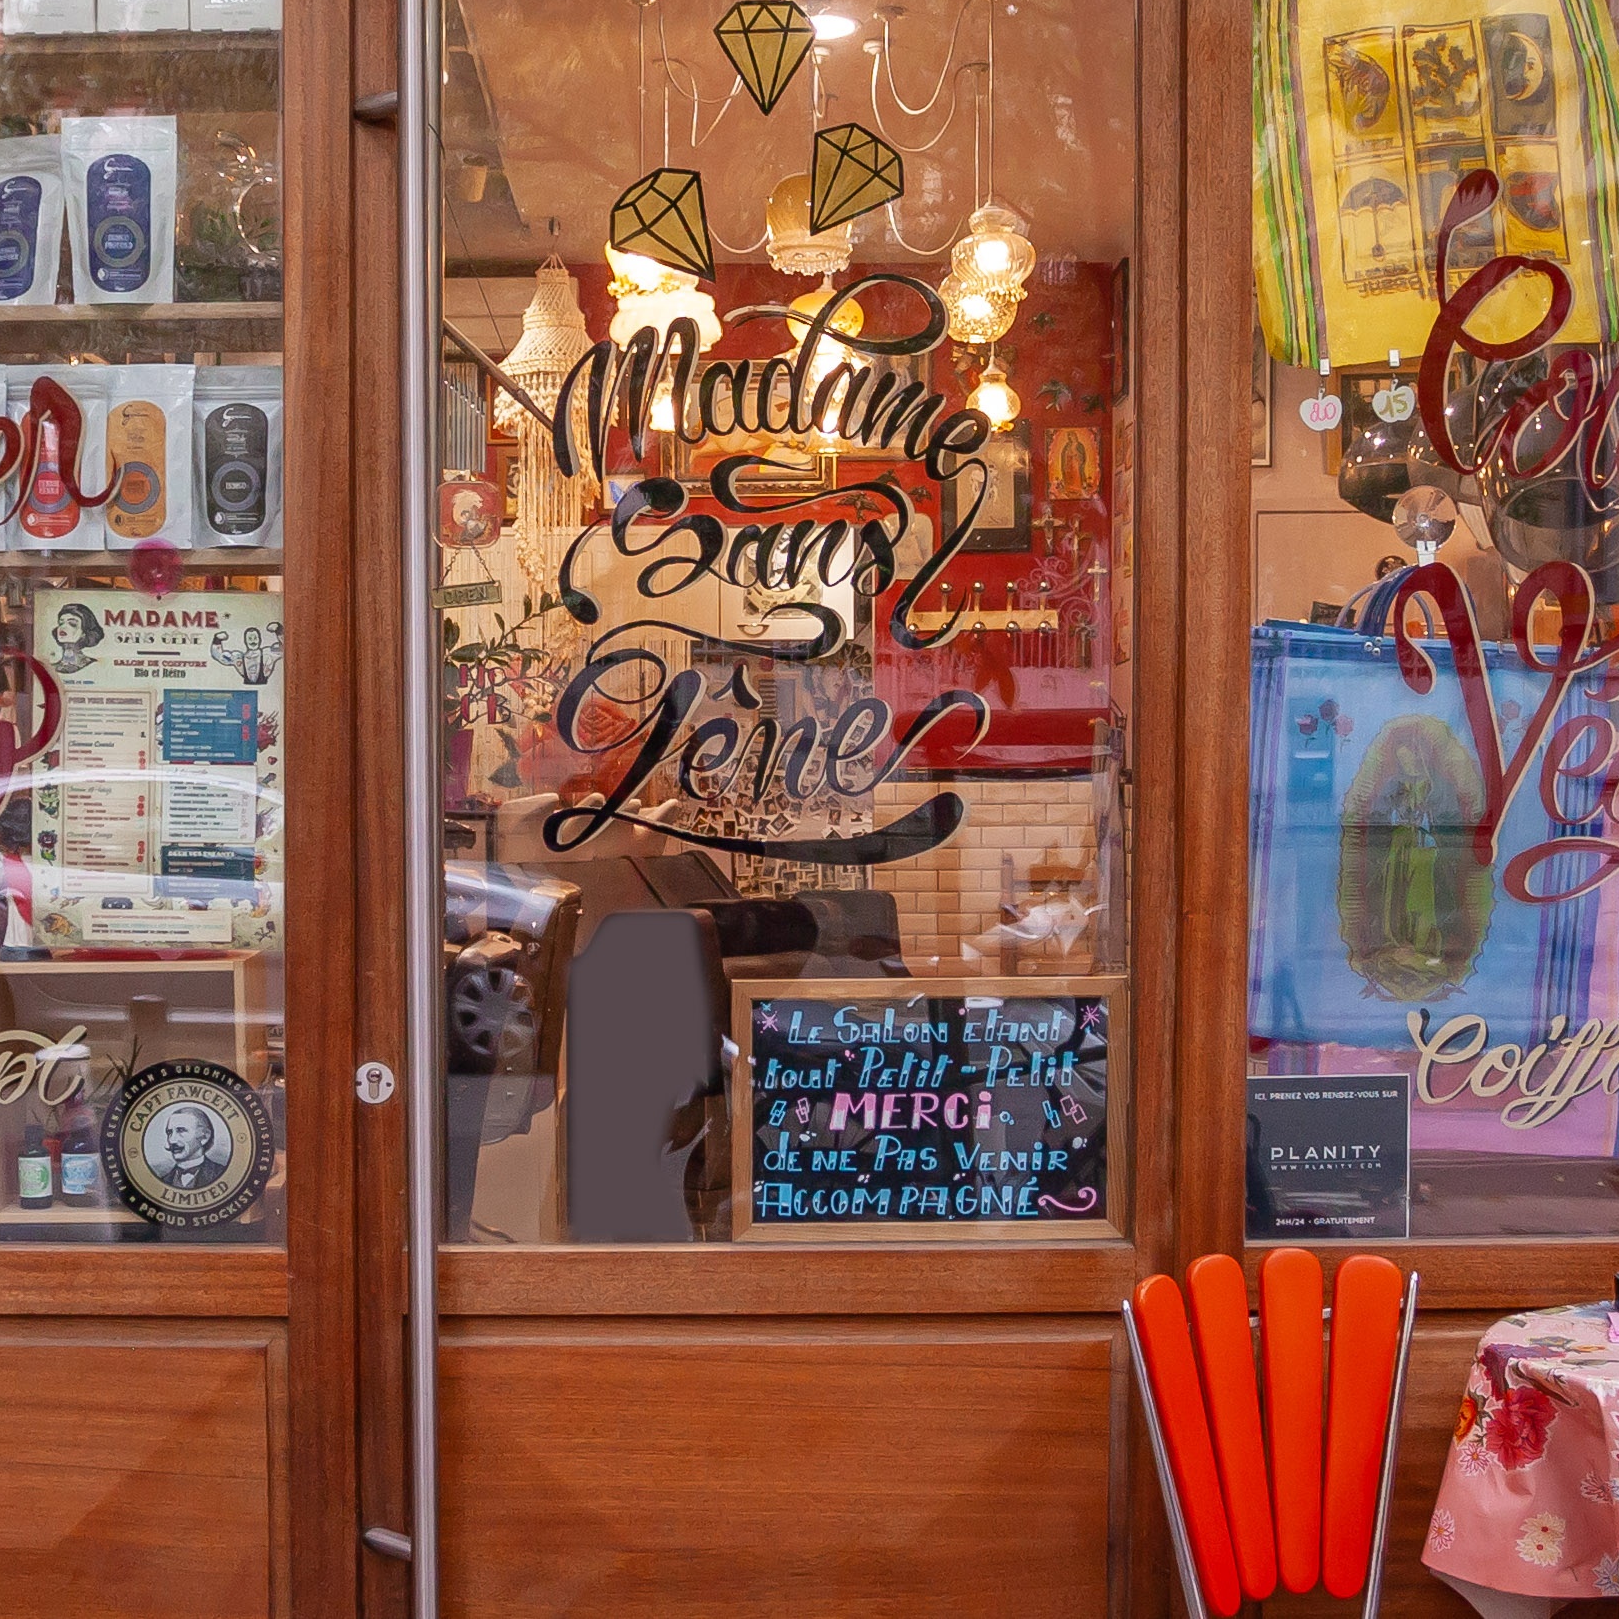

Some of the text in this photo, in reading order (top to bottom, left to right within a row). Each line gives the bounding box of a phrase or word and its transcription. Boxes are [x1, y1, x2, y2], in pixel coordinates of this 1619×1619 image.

[551, 272, 991, 486] Madame
[1379, 393, 1407, 418] 15
[559, 454, 916, 626] Sans
[443, 586, 488, 605] OPEN
[104, 610, 220, 629] MADAME
[113, 659, 144, 668] SALON
[1269, 1092, 1302, 1100] PRENEZ
[1303, 1092, 1320, 1100] VOS
[1322, 1091, 1380, 1099] RENDEZ-VOUS
[1382, 1090, 1398, 1098] SUR
[130, 1085, 239, 1132] CAPT FAWCETT
[1270, 1145, 1381, 1161] PLANITY
[160, 1181, 229, 1205] LIMITED
[139, 1190, 254, 1227] PROUD STOCKIST
[1275, 1216, 1375, 1226] 24H/24 GRATUITEMENT
